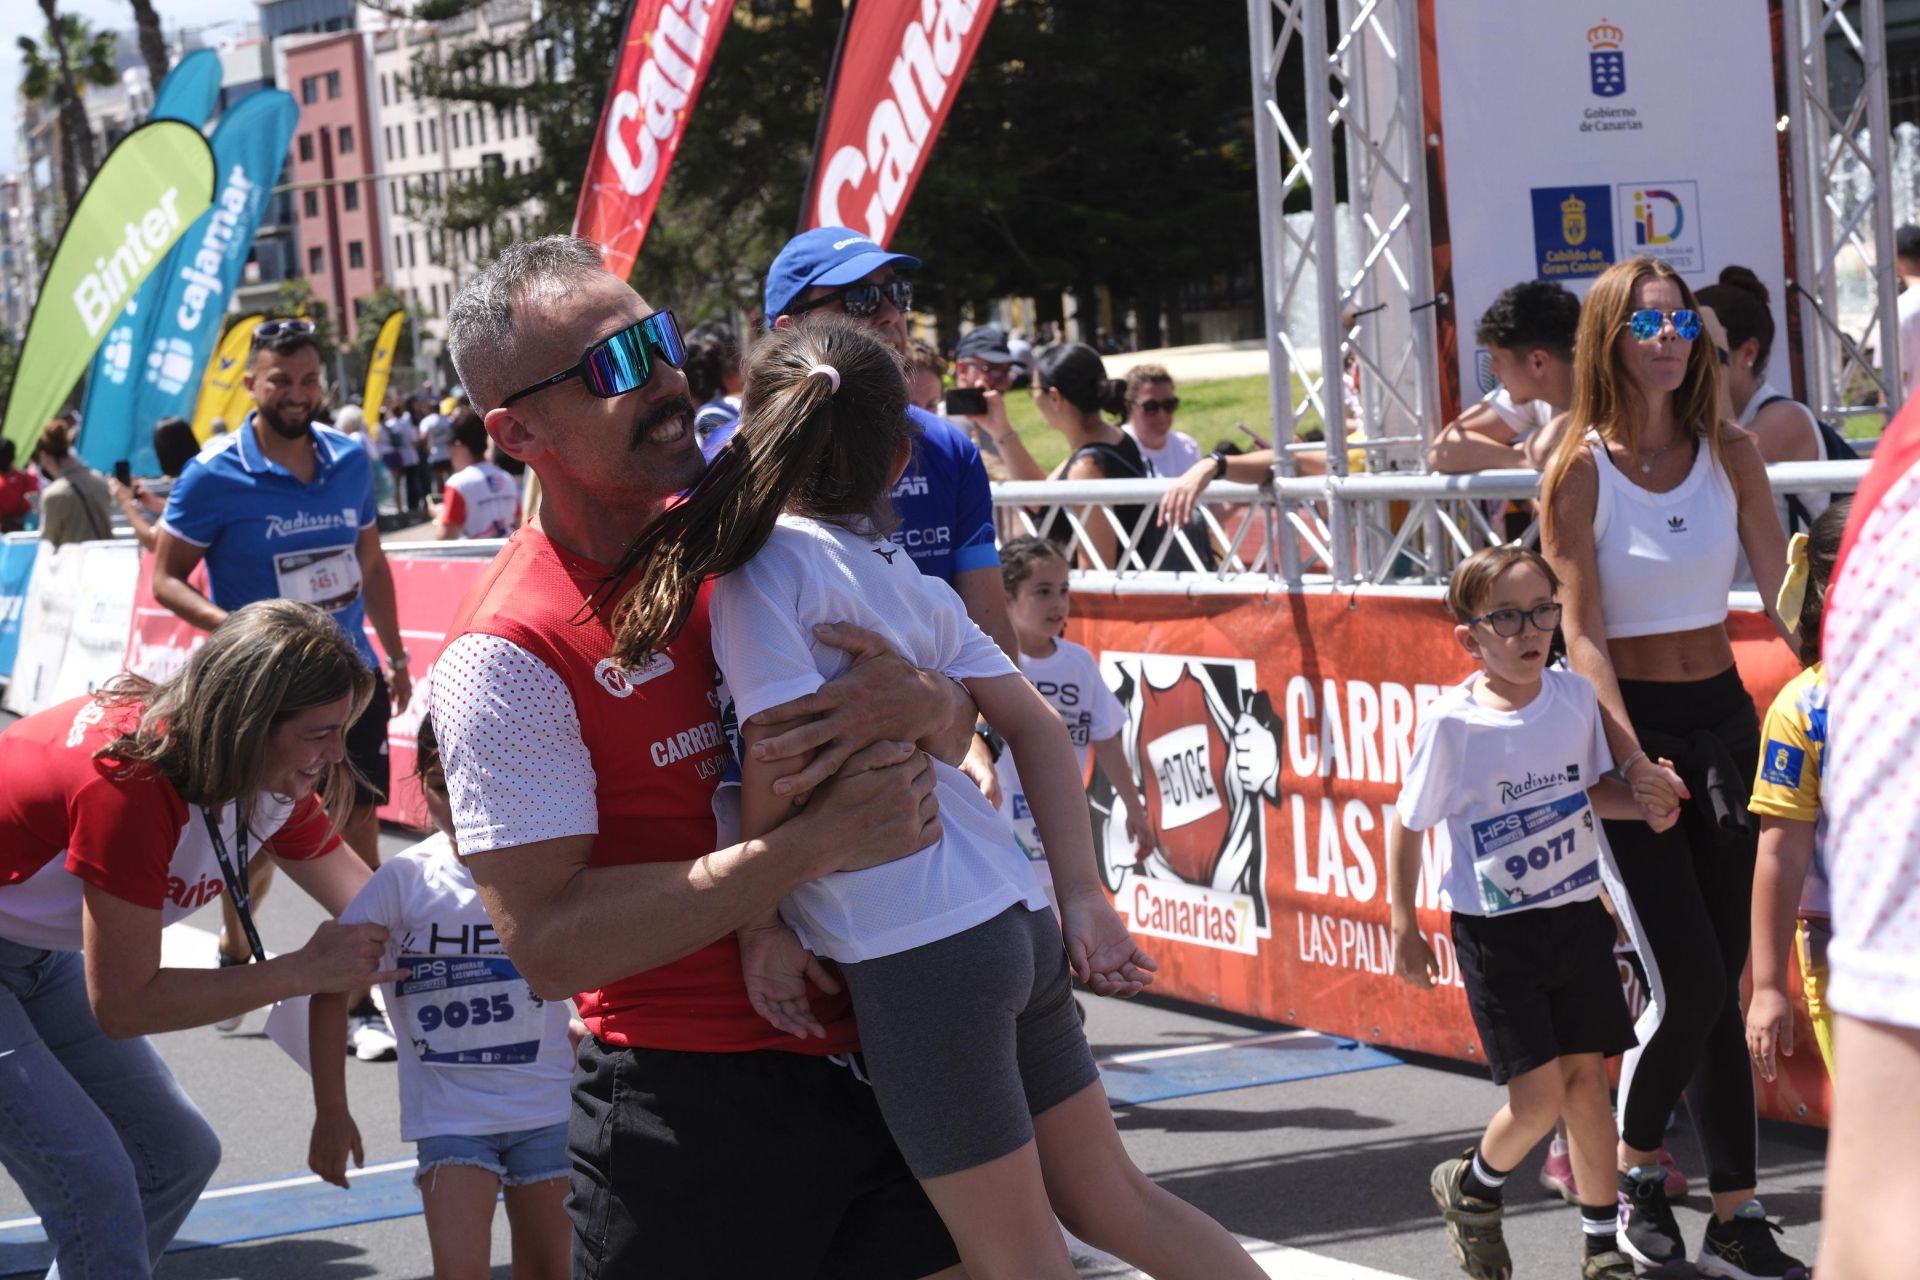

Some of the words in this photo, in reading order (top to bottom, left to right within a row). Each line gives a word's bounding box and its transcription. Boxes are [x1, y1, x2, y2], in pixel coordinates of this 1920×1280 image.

[1579, 120, 1593, 132] de
[1594, 119, 1643, 131] Canarias
[1584, 106, 1637, 119] Gobierno
[73, 186, 180, 338] Binter
[176, 164, 253, 331] cajamar
[1546, 249, 1588, 262] Cabildo
[1589, 248, 1603, 259] de
[1497, 771, 1567, 804] Radisson
[1291, 794, 1378, 903] LAS
[1478, 814, 1522, 844] HPS
[1505, 828, 1576, 881] 9077
[1297, 911, 1338, 967] LAS
[417, 993, 514, 1033] 9035
